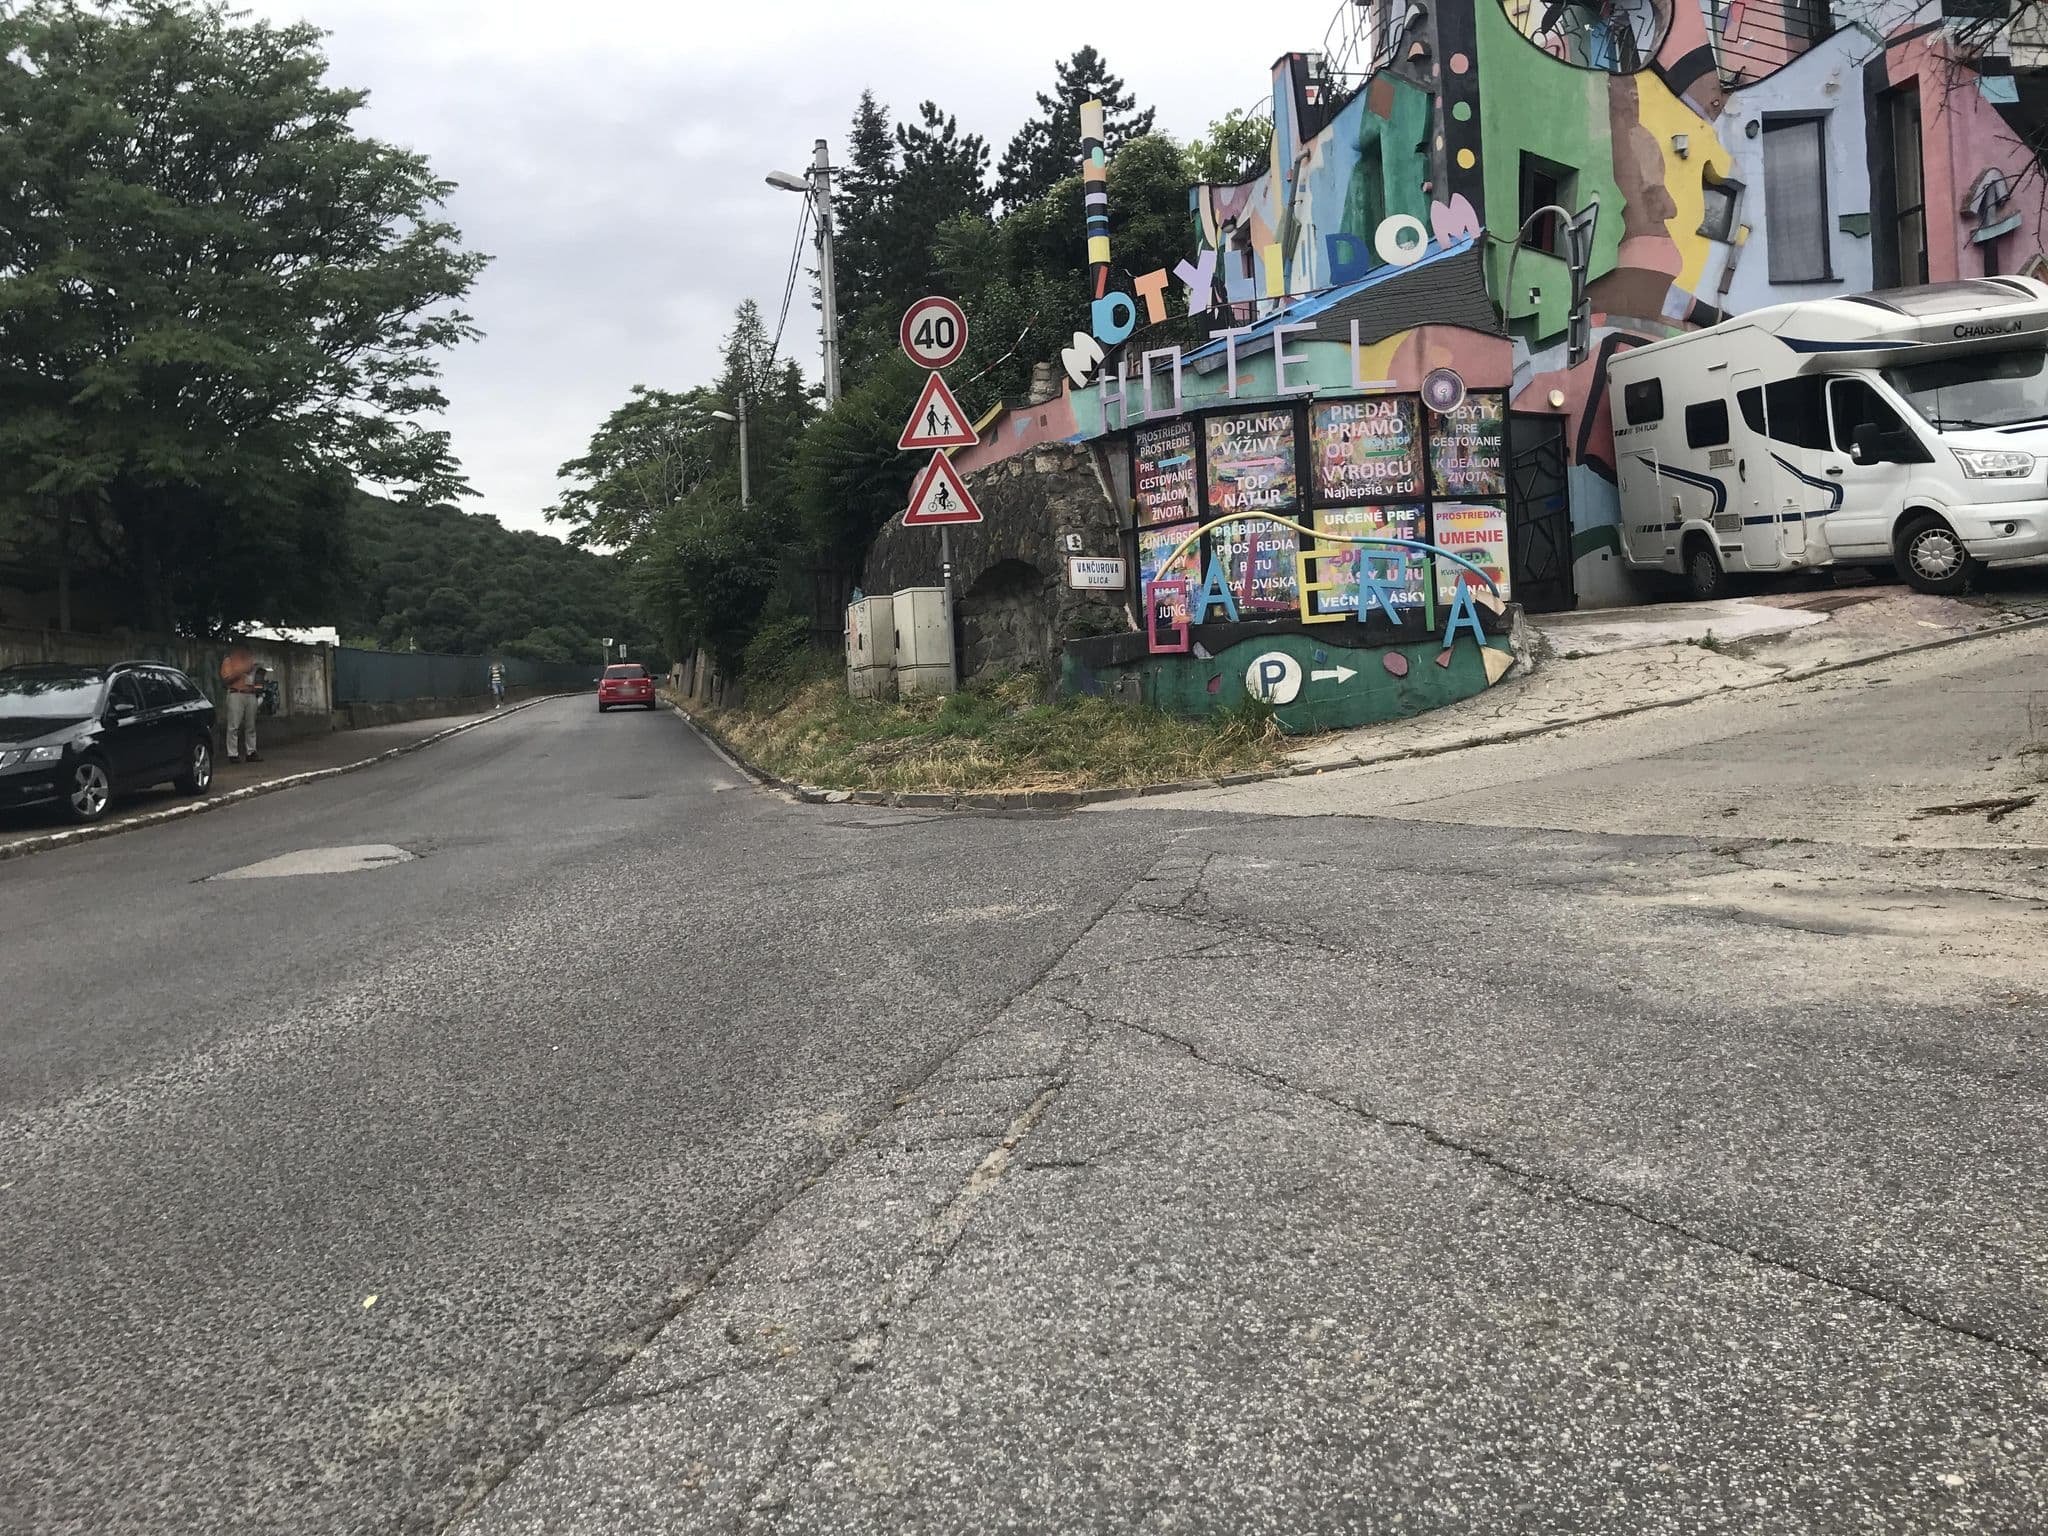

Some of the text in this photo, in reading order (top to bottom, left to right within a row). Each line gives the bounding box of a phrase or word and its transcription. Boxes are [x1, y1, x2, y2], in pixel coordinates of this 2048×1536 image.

[1325, 198, 1480, 286] DOM
[914, 316, 955, 349] 40
[1098, 319, 1396, 434] HOTEL
[1330, 400, 1398, 421] PREDAJ
[1136, 422, 1193, 445] PROSTRIEDKY
[1210, 416, 1290, 437] DOPLNKY
[1327, 418, 1404, 439] PRIAMO
[1456, 423, 1479, 434] PRE
[1140, 436, 1190, 457] PROSTREDIE
[1221, 435, 1280, 455] VÝŽIVY
[1326, 442, 1354, 458] OD
[1387, 436, 1410, 446] STOP
[1432, 436, 1501, 447] CESTOVANIE
[1139, 461, 1154, 473] PRE
[1322, 460, 1412, 482] VÝROBCU
[1436, 459, 1444, 469] K
[1139, 469, 1193, 490] CESTOVANIE
[1235, 475, 1268, 490] TOP
[1224, 489, 1281, 507] NATUR
[1324, 478, 1414, 500] Najlepšie v EÚ
[1324, 510, 1415, 525] URČENÉ PRE
[1436, 510, 1503, 520] PROSTRIEDKY
[1439, 530, 1504, 545] UMENIE
[1216, 539, 1294, 556] PROSREDIA
[1240, 559, 1272, 572] BTU
[1460, 551, 1493, 564] EDA
[1077, 561, 1119, 573] VANČUROVA
[1146, 549, 1487, 654] GALERIA
[1320, 590, 1425, 608] VEČNJ ÁSKY
[1159, 604, 1186, 619] JUNG
[1260, 660, 1287, 698] P
